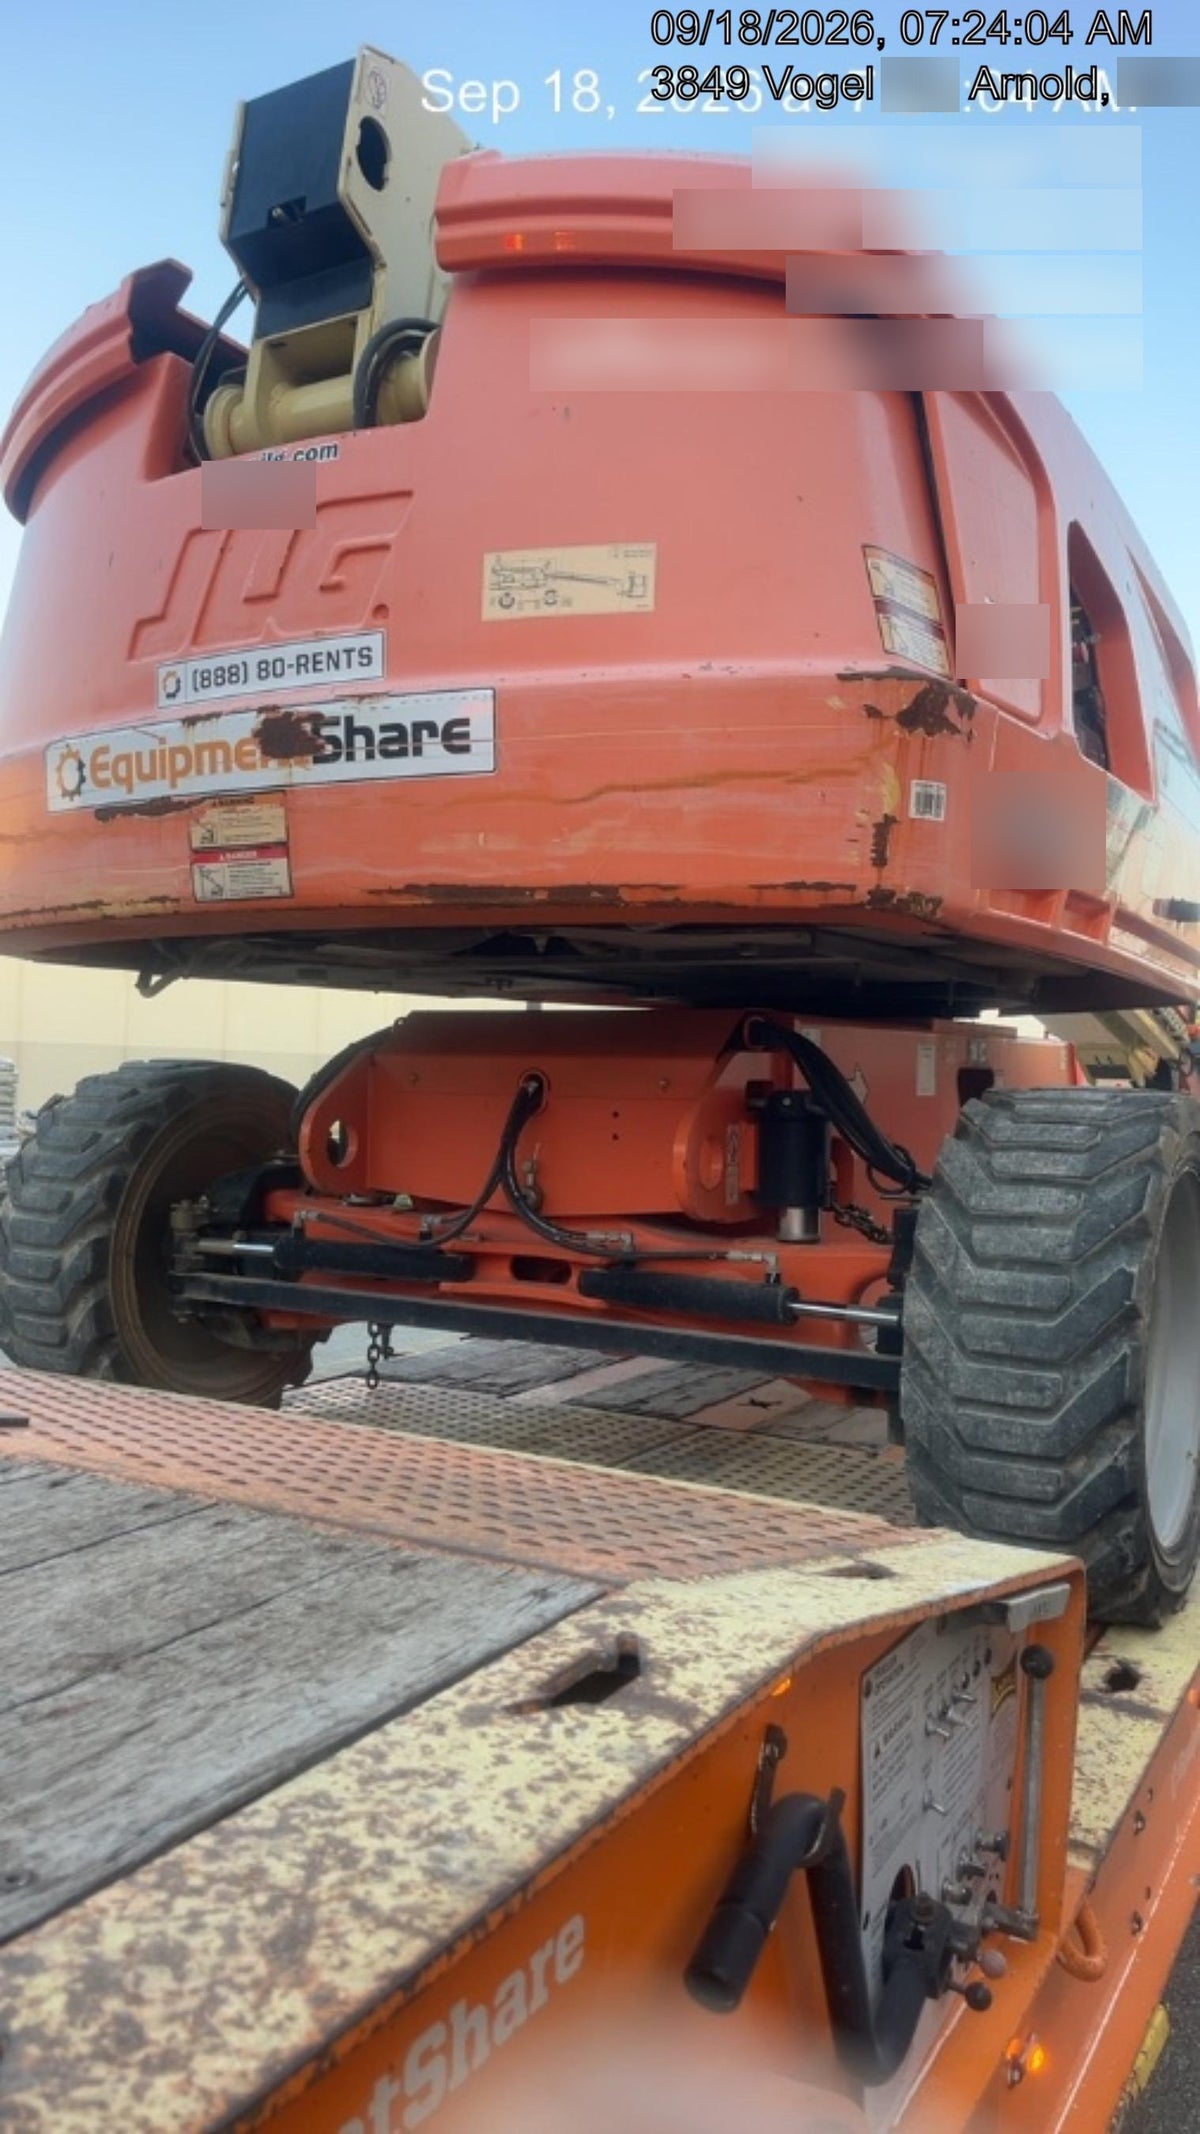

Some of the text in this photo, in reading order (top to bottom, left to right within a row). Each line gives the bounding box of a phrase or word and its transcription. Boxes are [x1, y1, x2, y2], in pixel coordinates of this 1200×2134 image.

[192, 647, 373, 692] (888) 80-RENTS
[90, 715, 471, 794] EquipmeShare
